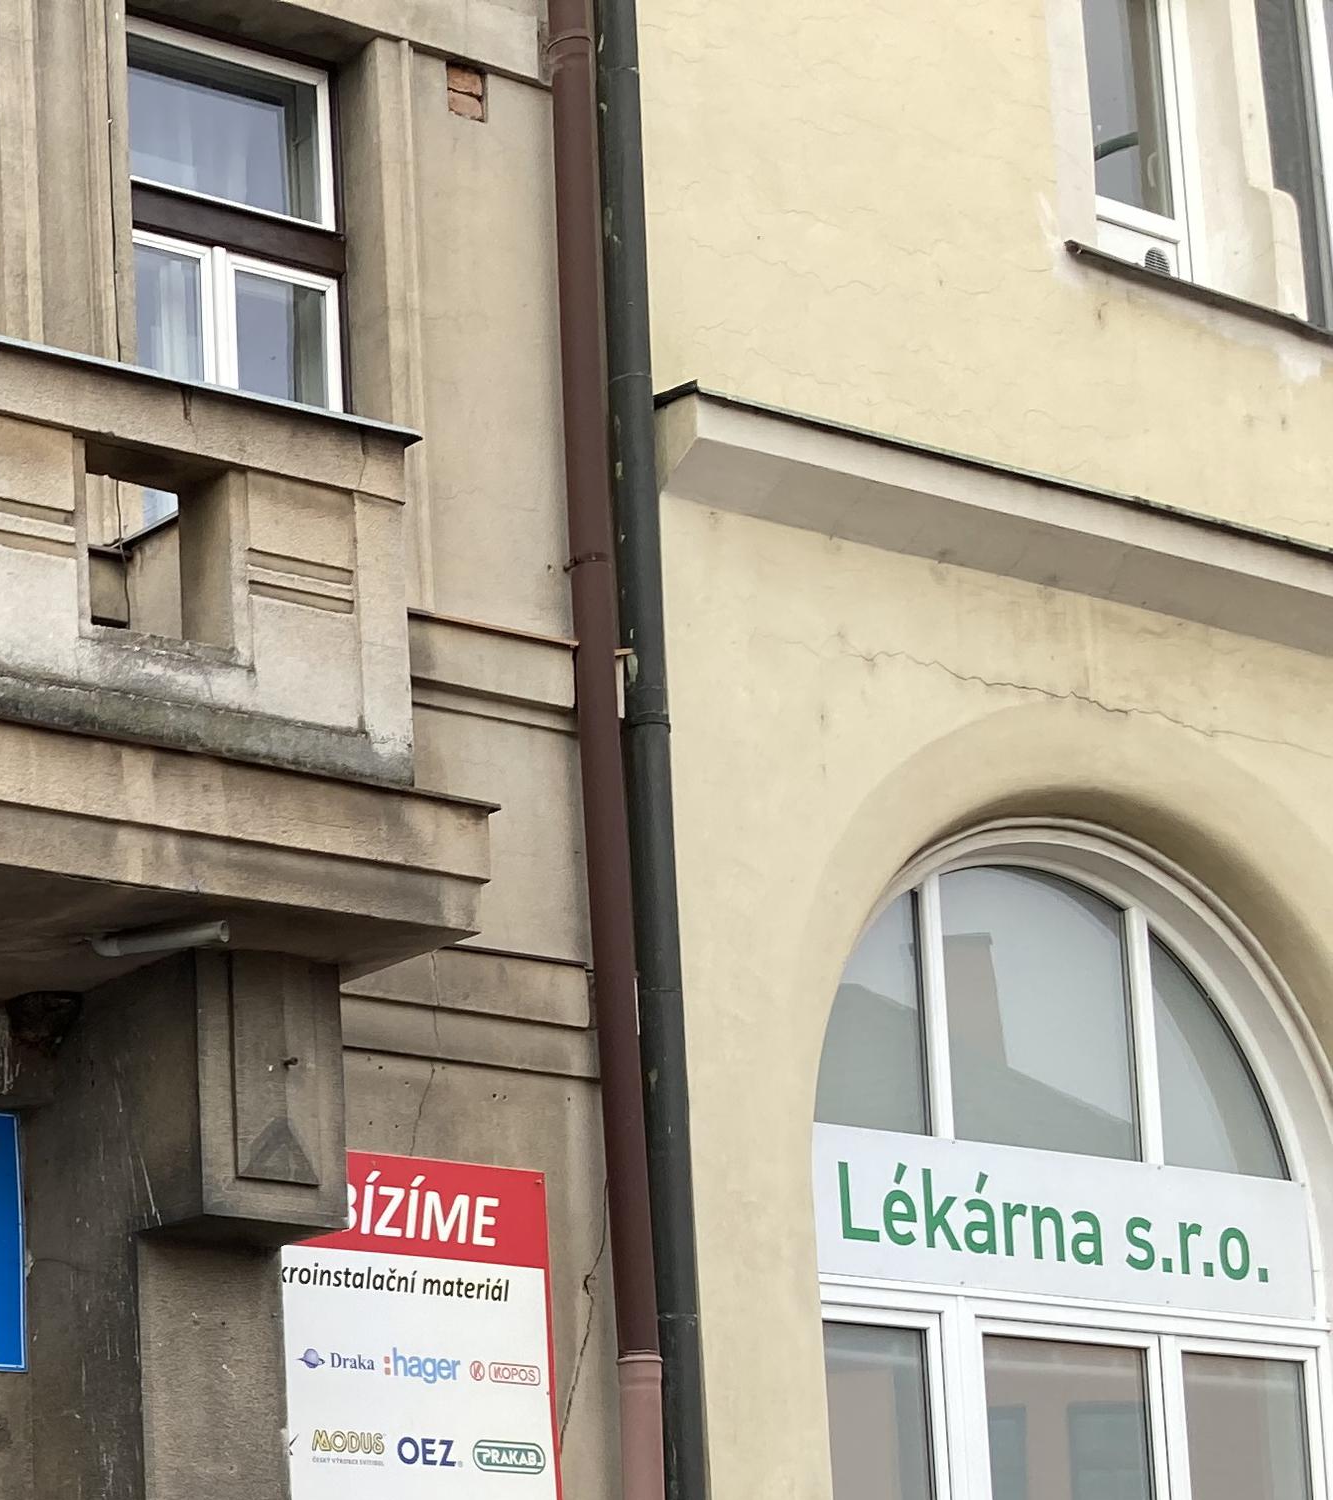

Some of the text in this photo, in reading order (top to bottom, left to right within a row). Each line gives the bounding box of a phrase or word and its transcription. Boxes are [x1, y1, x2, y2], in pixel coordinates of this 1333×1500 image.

[837, 1161, 1269, 1283] Lékárna s.r.o.
[422, 1277, 510, 1302] materiál
[331, 1352, 375, 1370] Draka
[494, 1367, 536, 1382] KOPOS
[312, 1429, 385, 1455] MODUS
[397, 1437, 457, 1467] OEZ
[480, 1448, 538, 1466] PRAKAB
